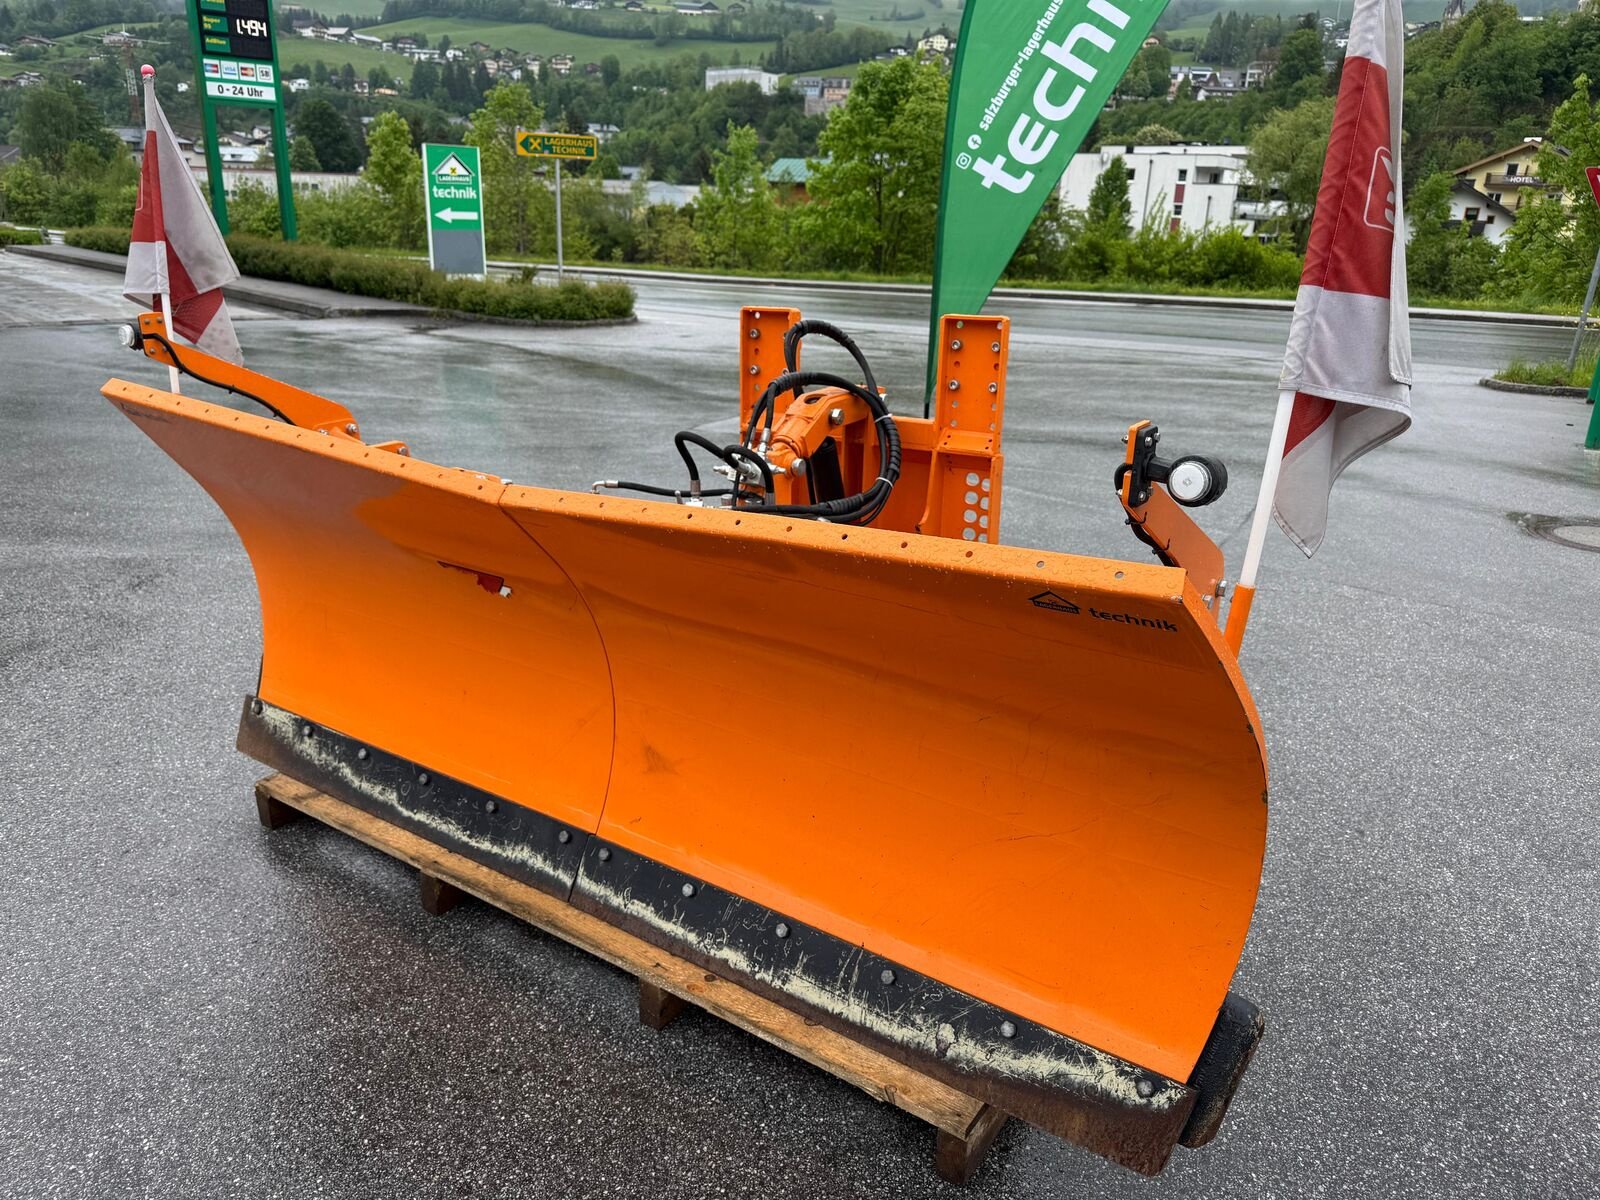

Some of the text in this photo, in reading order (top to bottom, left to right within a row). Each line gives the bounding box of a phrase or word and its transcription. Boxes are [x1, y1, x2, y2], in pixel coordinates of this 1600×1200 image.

[232, 85, 244, 96] 24
[247, 87, 263, 97] Uhr
[544, 137, 594, 147] LAGERHAUS
[552, 146, 587, 155] TECHNIK
[432, 185, 478, 199] technik
[1088, 607, 1179, 632] technik
